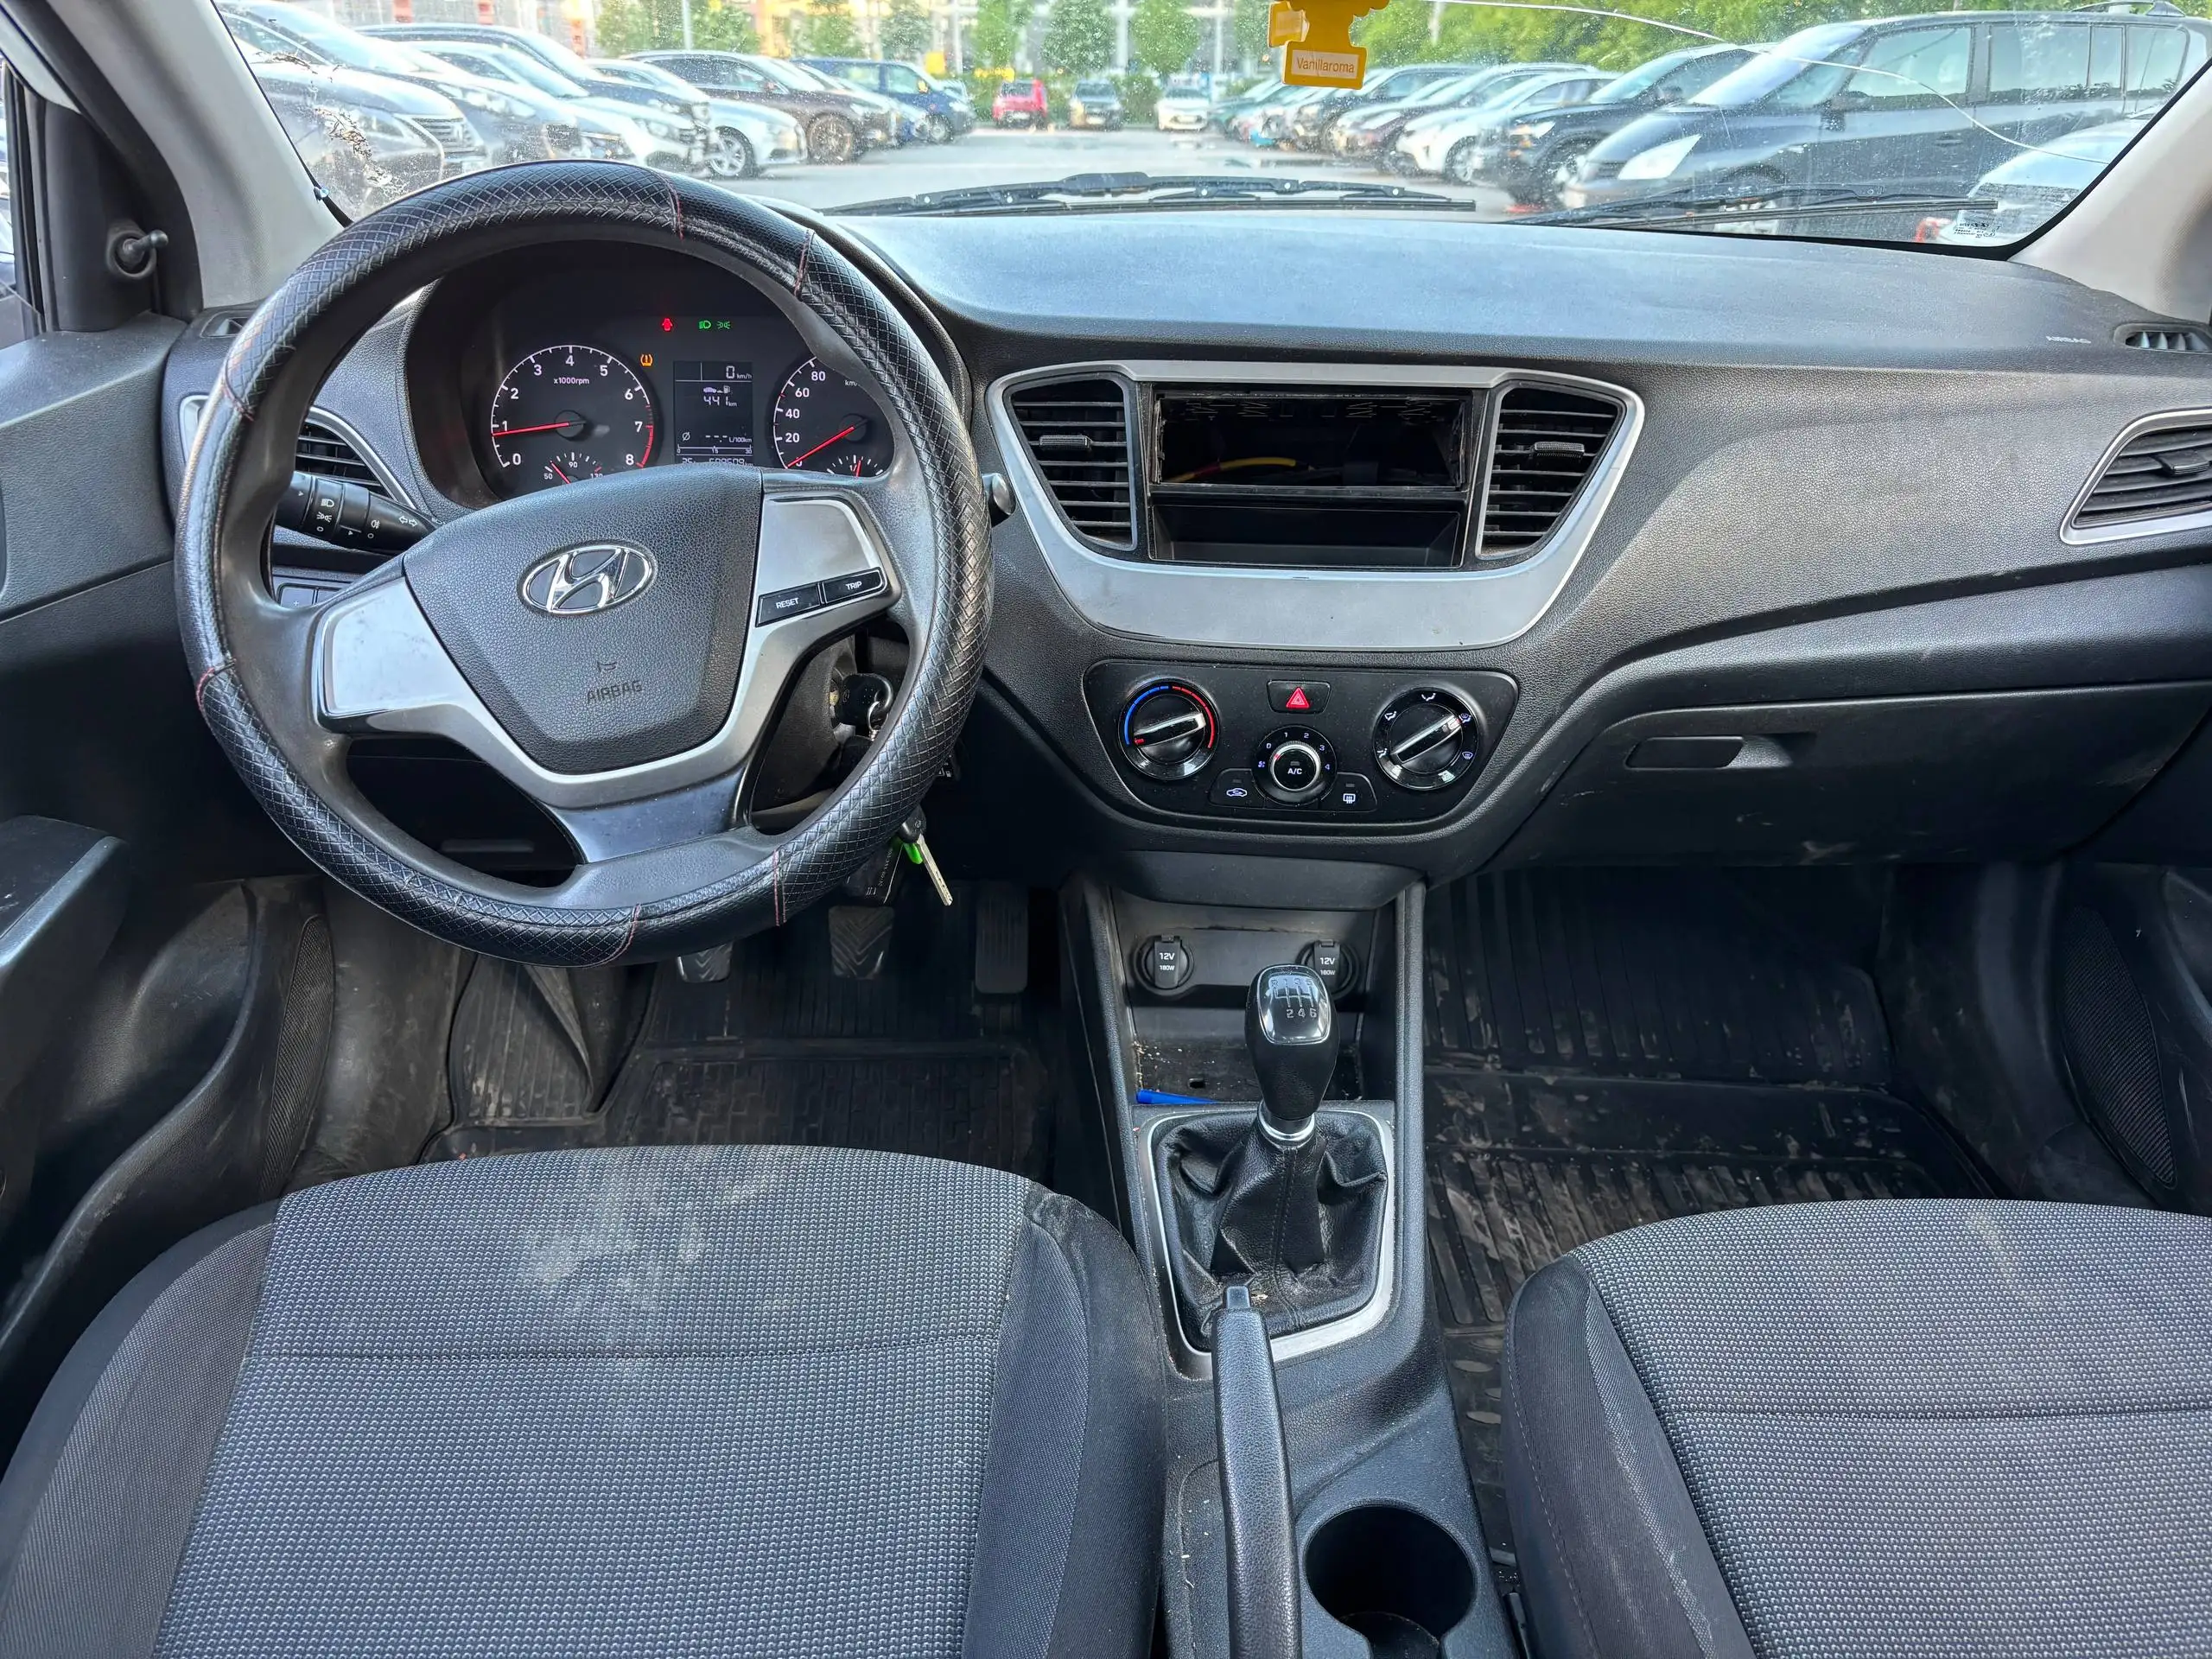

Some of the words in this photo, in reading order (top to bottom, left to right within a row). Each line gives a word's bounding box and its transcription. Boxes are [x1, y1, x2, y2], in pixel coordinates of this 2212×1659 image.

[1296, 57, 1355, 73] Vanillaroma
[566, 355, 575, 366] 4
[533, 364, 543, 376] 3
[600, 365, 608, 377] 5
[726, 365, 735, 379] 0
[810, 371, 826, 381] 80
[510, 388, 519, 400] 2
[624, 389, 633, 400] 6
[794, 387, 810, 397] 60
[703, 396, 728, 406] 441
[785, 409, 800, 419] 40
[501, 420, 508, 432] 1
[634, 421, 643, 432] 7
[785, 433, 800, 443] 20
[512, 453, 522, 466] 0
[625, 454, 634, 466] 8
[845, 581, 862, 590] TRIP
[775, 597, 799, 609] RESET
[587, 680, 642, 705] AIRBAG
[1159, 952, 1175, 961] 12V
[1319, 957, 1336, 965] 12V
[1286, 1008, 1294, 1019] 2
[1298, 1007, 1306, 1018] 4
[1309, 1007, 1317, 1018] 6
